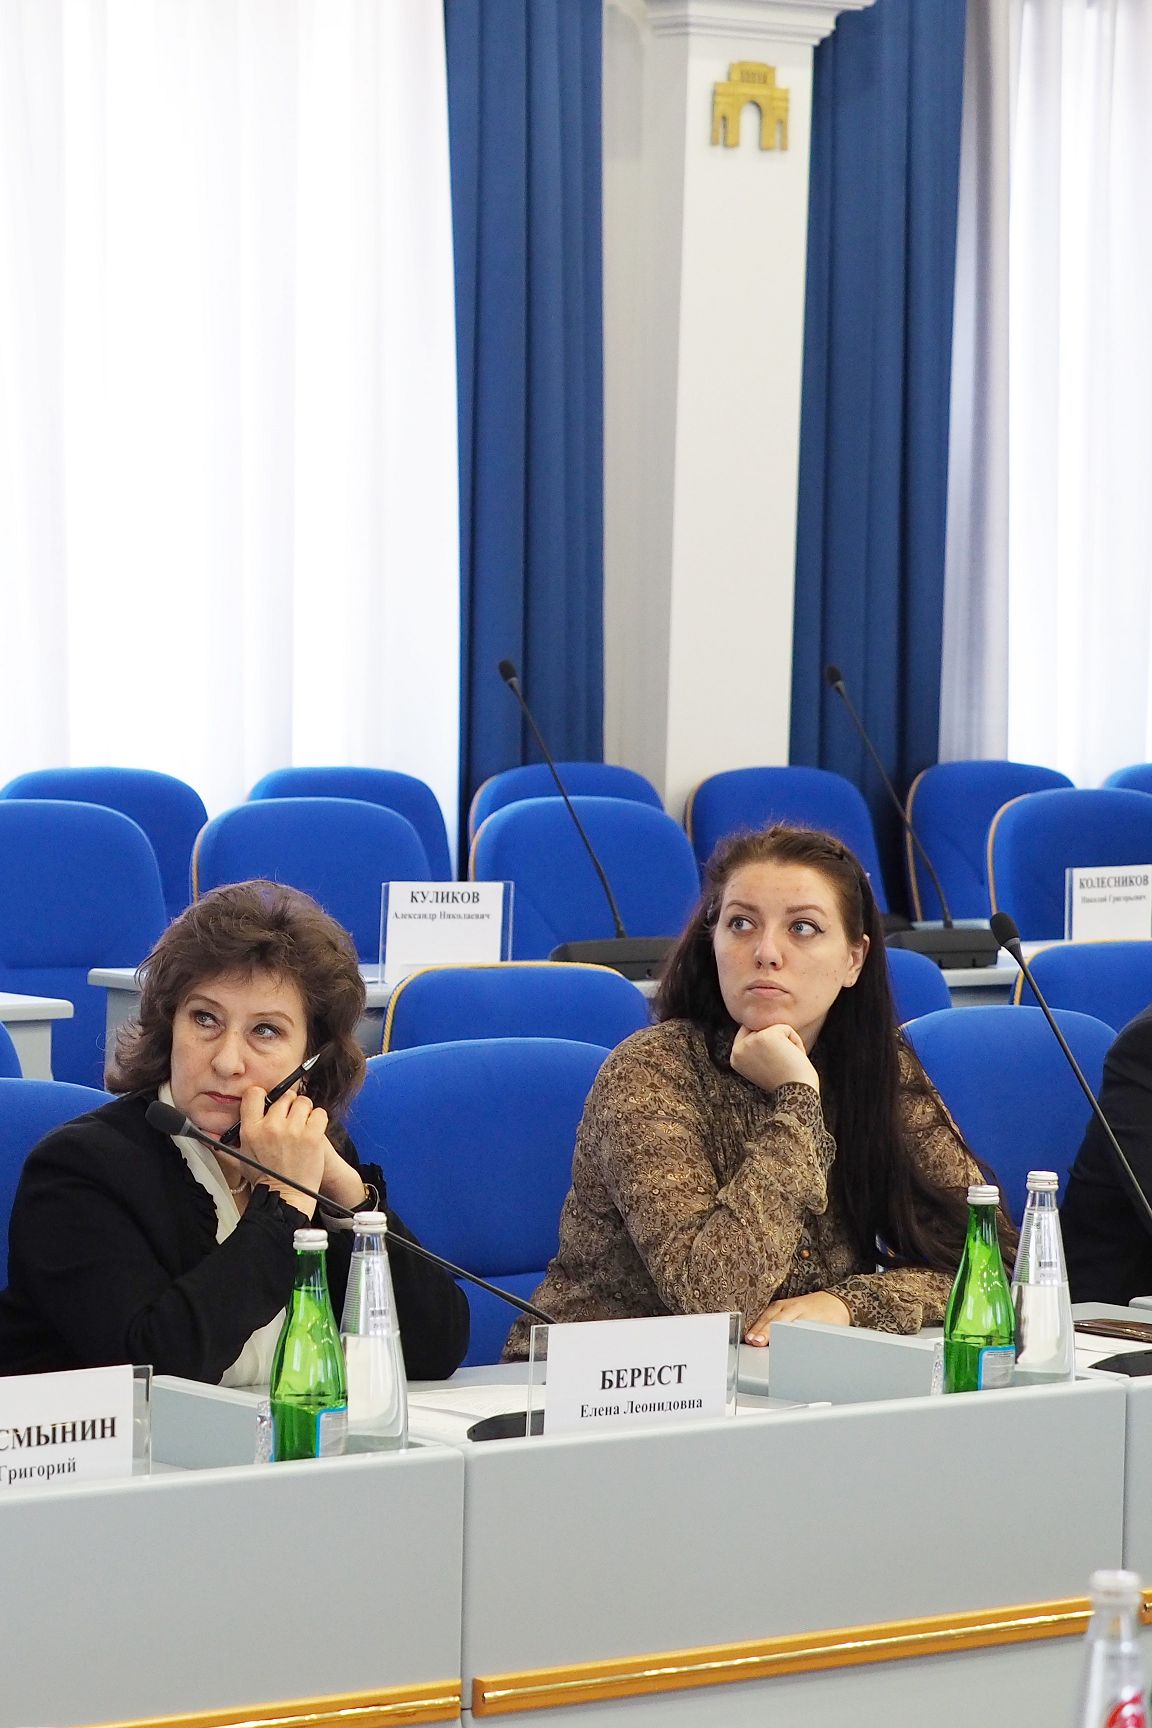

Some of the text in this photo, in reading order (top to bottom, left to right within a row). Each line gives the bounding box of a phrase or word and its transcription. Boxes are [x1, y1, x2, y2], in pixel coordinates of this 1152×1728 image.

[1079, 875, 1150, 889] КОЛЕСНИКОВ
[410, 891, 480, 904] КУЛИКОВ
[393, 911, 491, 921] Александр Николаевич
[600, 1364, 687, 1390] БЕРЕСТ
[580, 1398, 703, 1418] Елена Леонидовна
